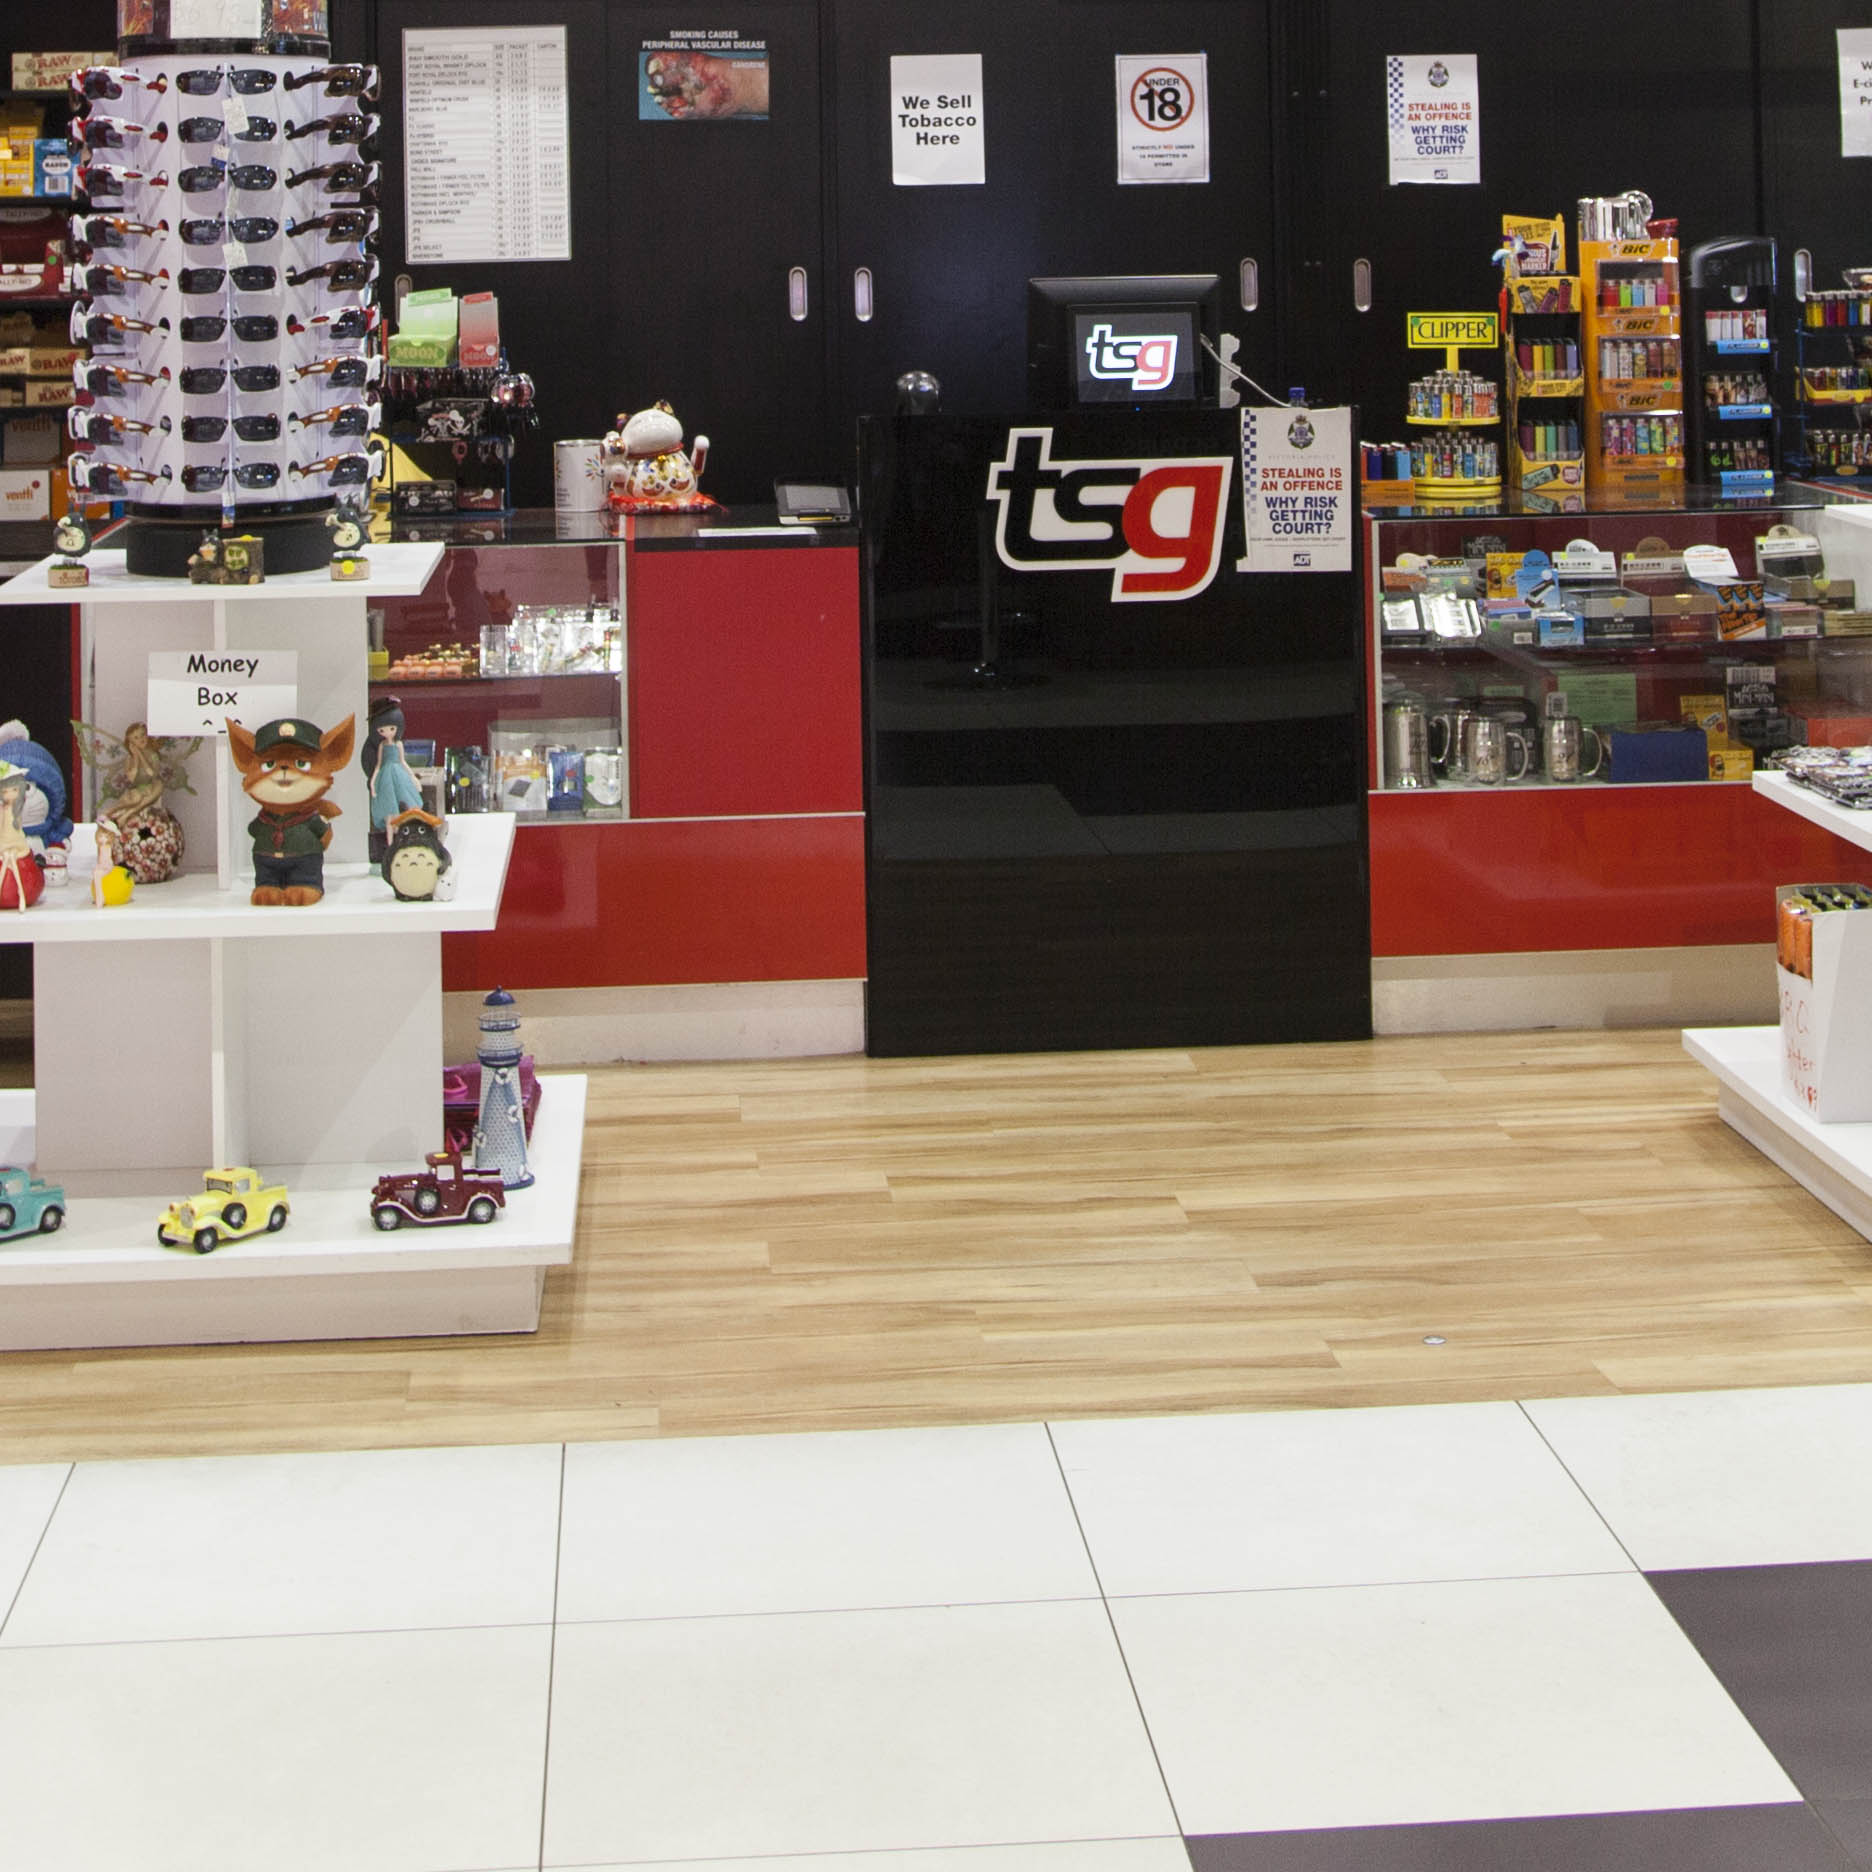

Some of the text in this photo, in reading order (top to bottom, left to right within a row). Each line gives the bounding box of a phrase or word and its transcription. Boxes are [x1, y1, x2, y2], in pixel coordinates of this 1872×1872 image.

[669, 30, 739, 39] SMOKING CAUSES
[642, 40, 766, 49] PERIPHERAL VASCULAR DISEASE
[37, 55, 72, 68] RAW
[1144, 78, 1180, 86] UNDER
[902, 95, 972, 110] We Sell
[1139, 87, 1182, 121] 18
[1408, 102, 1471, 111] STEALING IS
[898, 114, 977, 128] Tobacco
[1408, 112, 1472, 121] AN OFFENCE
[1411, 125, 1469, 135] WHY RISK
[916, 132, 960, 145] Here
[1415, 135, 1466, 145] GETTING
[1417, 146, 1465, 155] COURT?
[1418, 321, 1488, 339] CLIPPER
[1088, 325, 1176, 388] tsg
[38, 387, 71, 401] RAW
[1262, 468, 1342, 478] STEALING IS
[1261, 480, 1343, 491] AN OFFENCE
[1265, 496, 1338, 508] WHY RISK
[996, 435, 1224, 595] tsg
[1269, 510, 1334, 521] GETTING
[1272, 523, 1332, 535] COURT?
[187, 654, 259, 678] Money
[197, 687, 238, 706] Box
